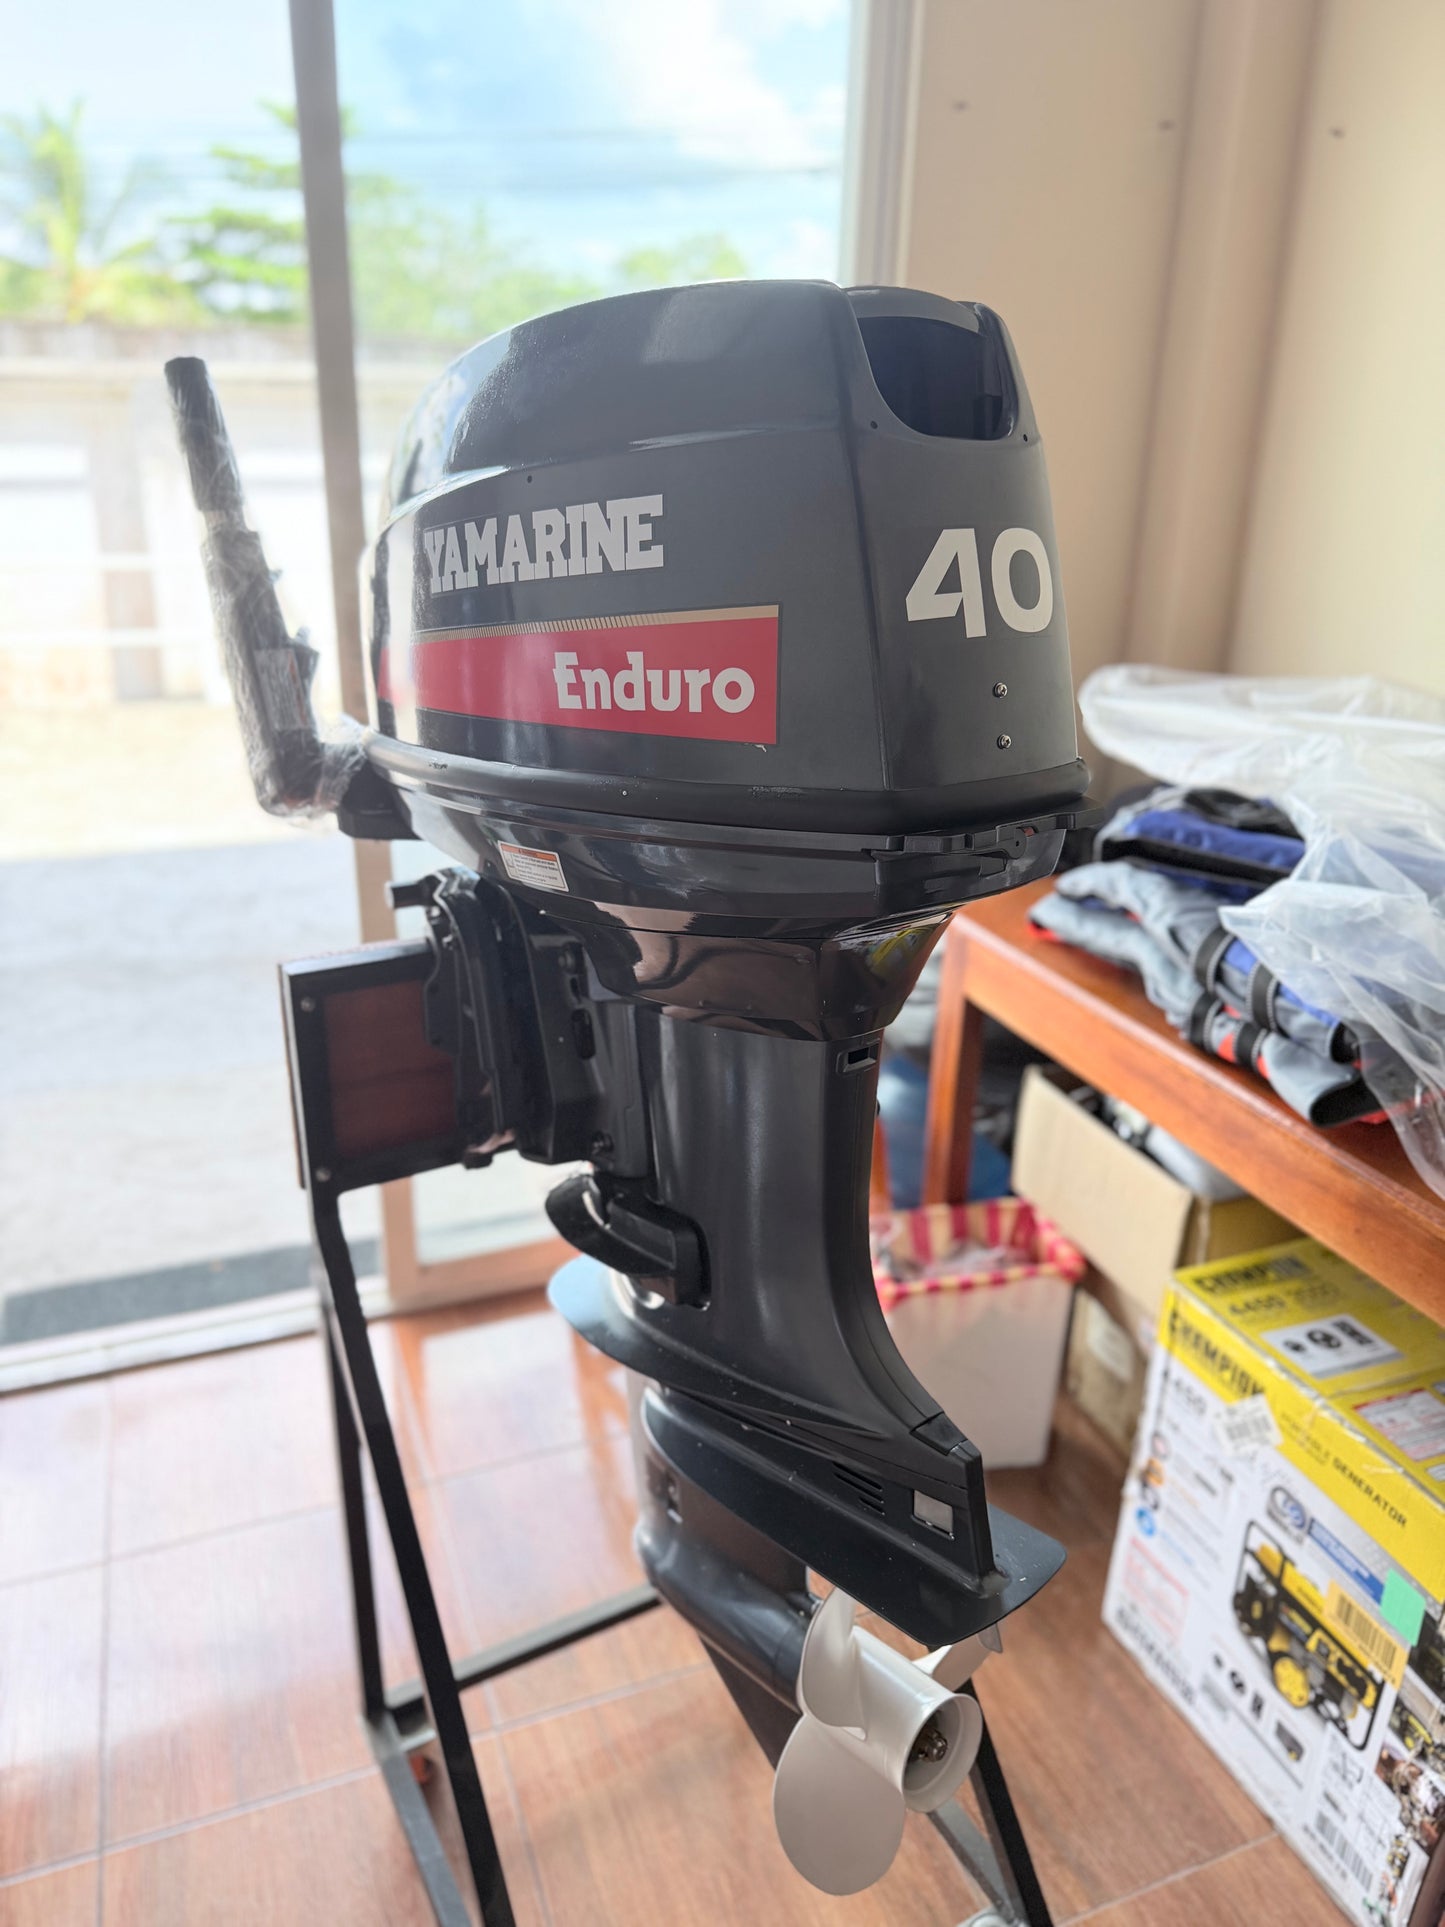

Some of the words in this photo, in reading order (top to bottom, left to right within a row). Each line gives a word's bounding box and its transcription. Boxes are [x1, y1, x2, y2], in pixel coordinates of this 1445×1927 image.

[423, 494, 664, 594] YAMARINE
[905, 527, 1054, 639] 40
[552, 650, 756, 714] Enduro
[1332, 1456, 1408, 1527] GENERATOR
